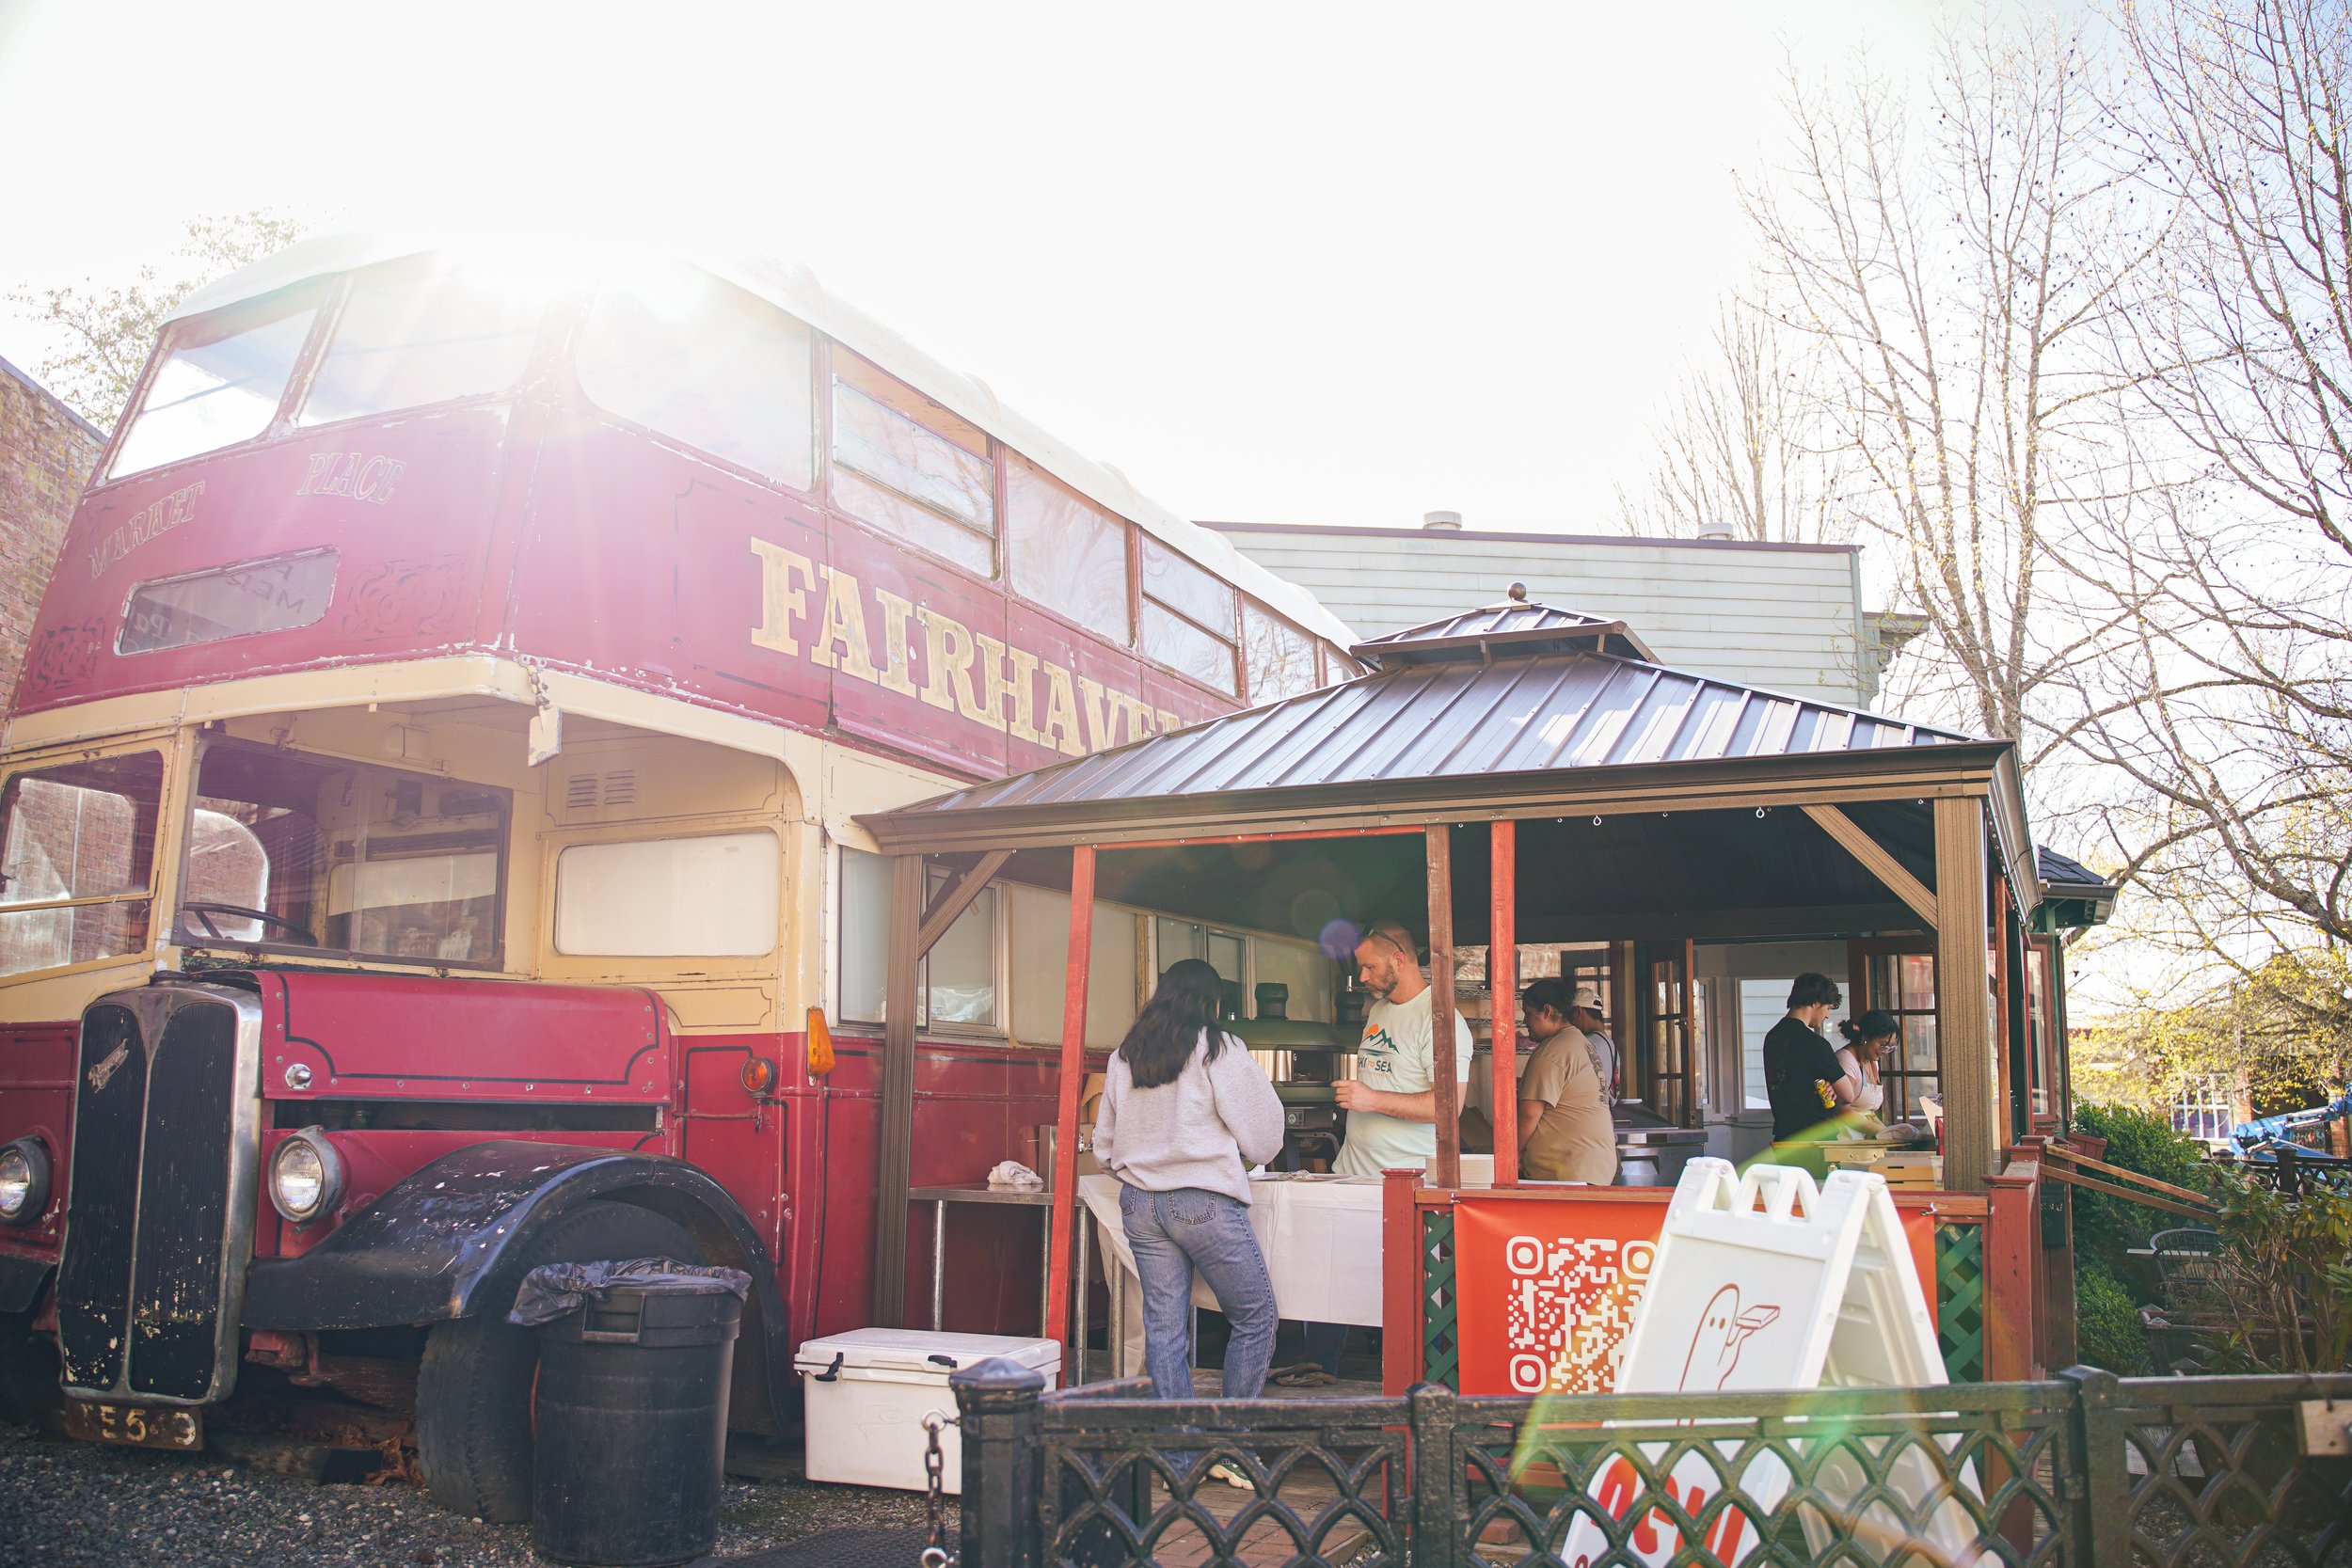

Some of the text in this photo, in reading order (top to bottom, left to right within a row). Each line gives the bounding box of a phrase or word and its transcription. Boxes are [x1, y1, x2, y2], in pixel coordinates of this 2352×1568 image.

[88, 452, 407, 583] MARKET PLACE
[750, 536, 1196, 756] FAIRHAVE
[1358, 1056, 1368, 1069] KI
[1375, 1059, 1392, 1073] SEA
